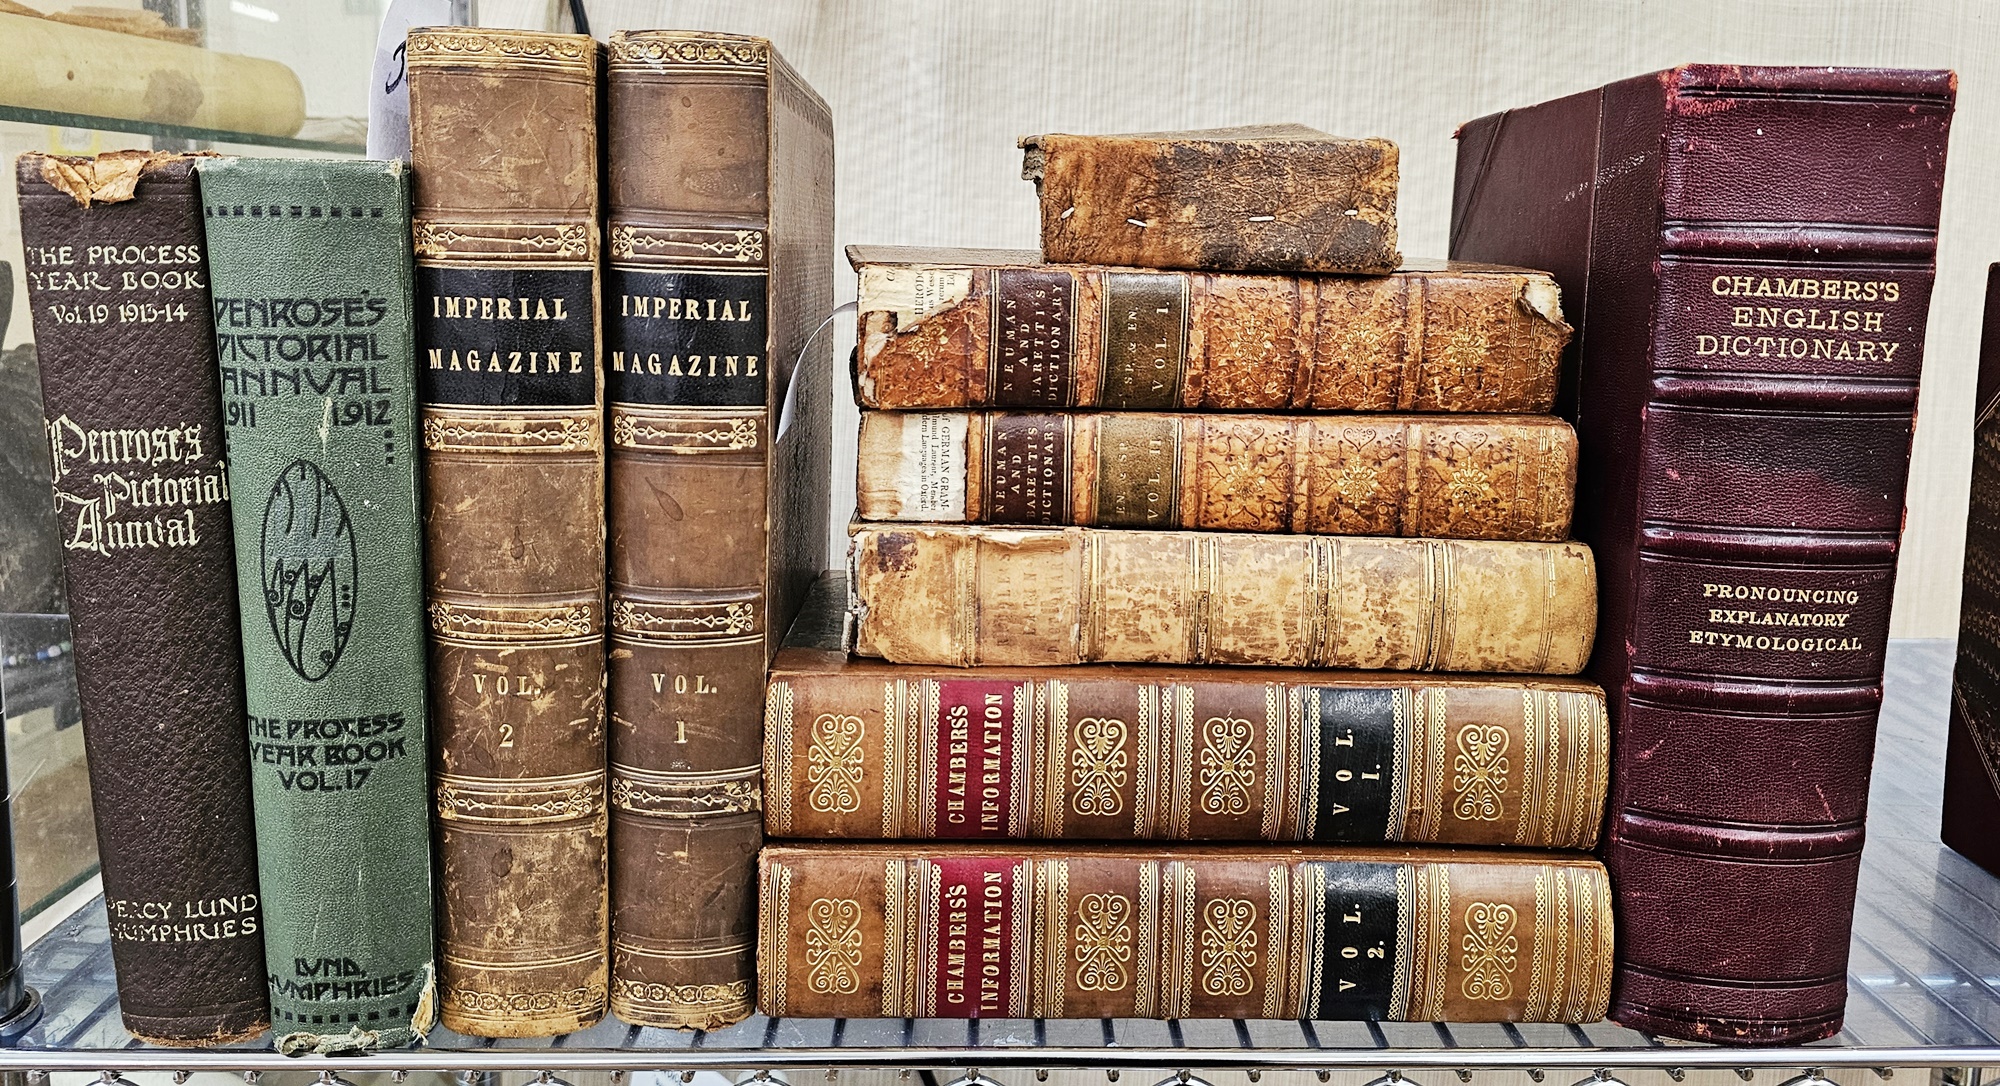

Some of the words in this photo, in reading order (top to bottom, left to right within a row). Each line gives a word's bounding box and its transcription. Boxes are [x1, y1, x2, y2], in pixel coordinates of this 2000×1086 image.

[27, 246, 74, 265] THE
[87, 245, 201, 265] PROCESS
[30, 271, 111, 291] YEAR
[122, 270, 206, 290] BOOK
[1711, 275, 1900, 302] CHAMBERS'S
[433, 296, 567, 321] IMPERIAL
[621, 295, 752, 322] IMPERIAL
[1731, 306, 1884, 332] ENGLISH
[218, 333, 388, 362] PICTORIAL
[1003, 299, 1017, 391] NEUMAN
[1018, 323, 1031, 367] AND
[1032, 289, 1047, 397] BARETTI'S
[1048, 284, 1064, 401] DICTIONARY
[1695, 335, 1899, 362] DICTIONARY
[428, 349, 583, 374] MAGAZINE
[612, 351, 759, 377] MAGAZINE
[1152, 331, 1169, 392] VOL.
[332, 400, 392, 426] 1912
[45, 414, 204, 484] Penrose's
[940, 426, 950, 473] GERMAN
[995, 431, 1008, 513] NEUMAN
[1010, 455, 1022, 494] AND
[1026, 427, 1039, 519] BARETTI'S
[1041, 420, 1055, 525] DICTIONARY
[93, 460, 230, 519] Pictorial
[1703, 583, 1859, 605] PRONOUNCING
[1708, 608, 1850, 628] EXPLANATORY
[1688, 630, 1862, 652] ETYMOLOGICAL
[473, 674, 541, 696] VOL.
[651, 673, 718, 694] VOL.
[287, 712, 405, 740] PROCESS
[499, 723, 514, 748] 2
[250, 740, 317, 767] YEAR
[325, 736, 408, 766] BOOK
[945, 705, 969, 824] CHAMBERS'S
[981, 693, 1003, 831] INFORMATION
[1333, 728, 1354, 816] VOL.
[185, 893, 259, 919] LUND
[945, 884, 968, 1004] CHAMBERS'S
[980, 871, 1003, 1011] INFORMATION
[1339, 903, 1362, 992] VOL.
[1367, 940, 1385, 959] 2.
